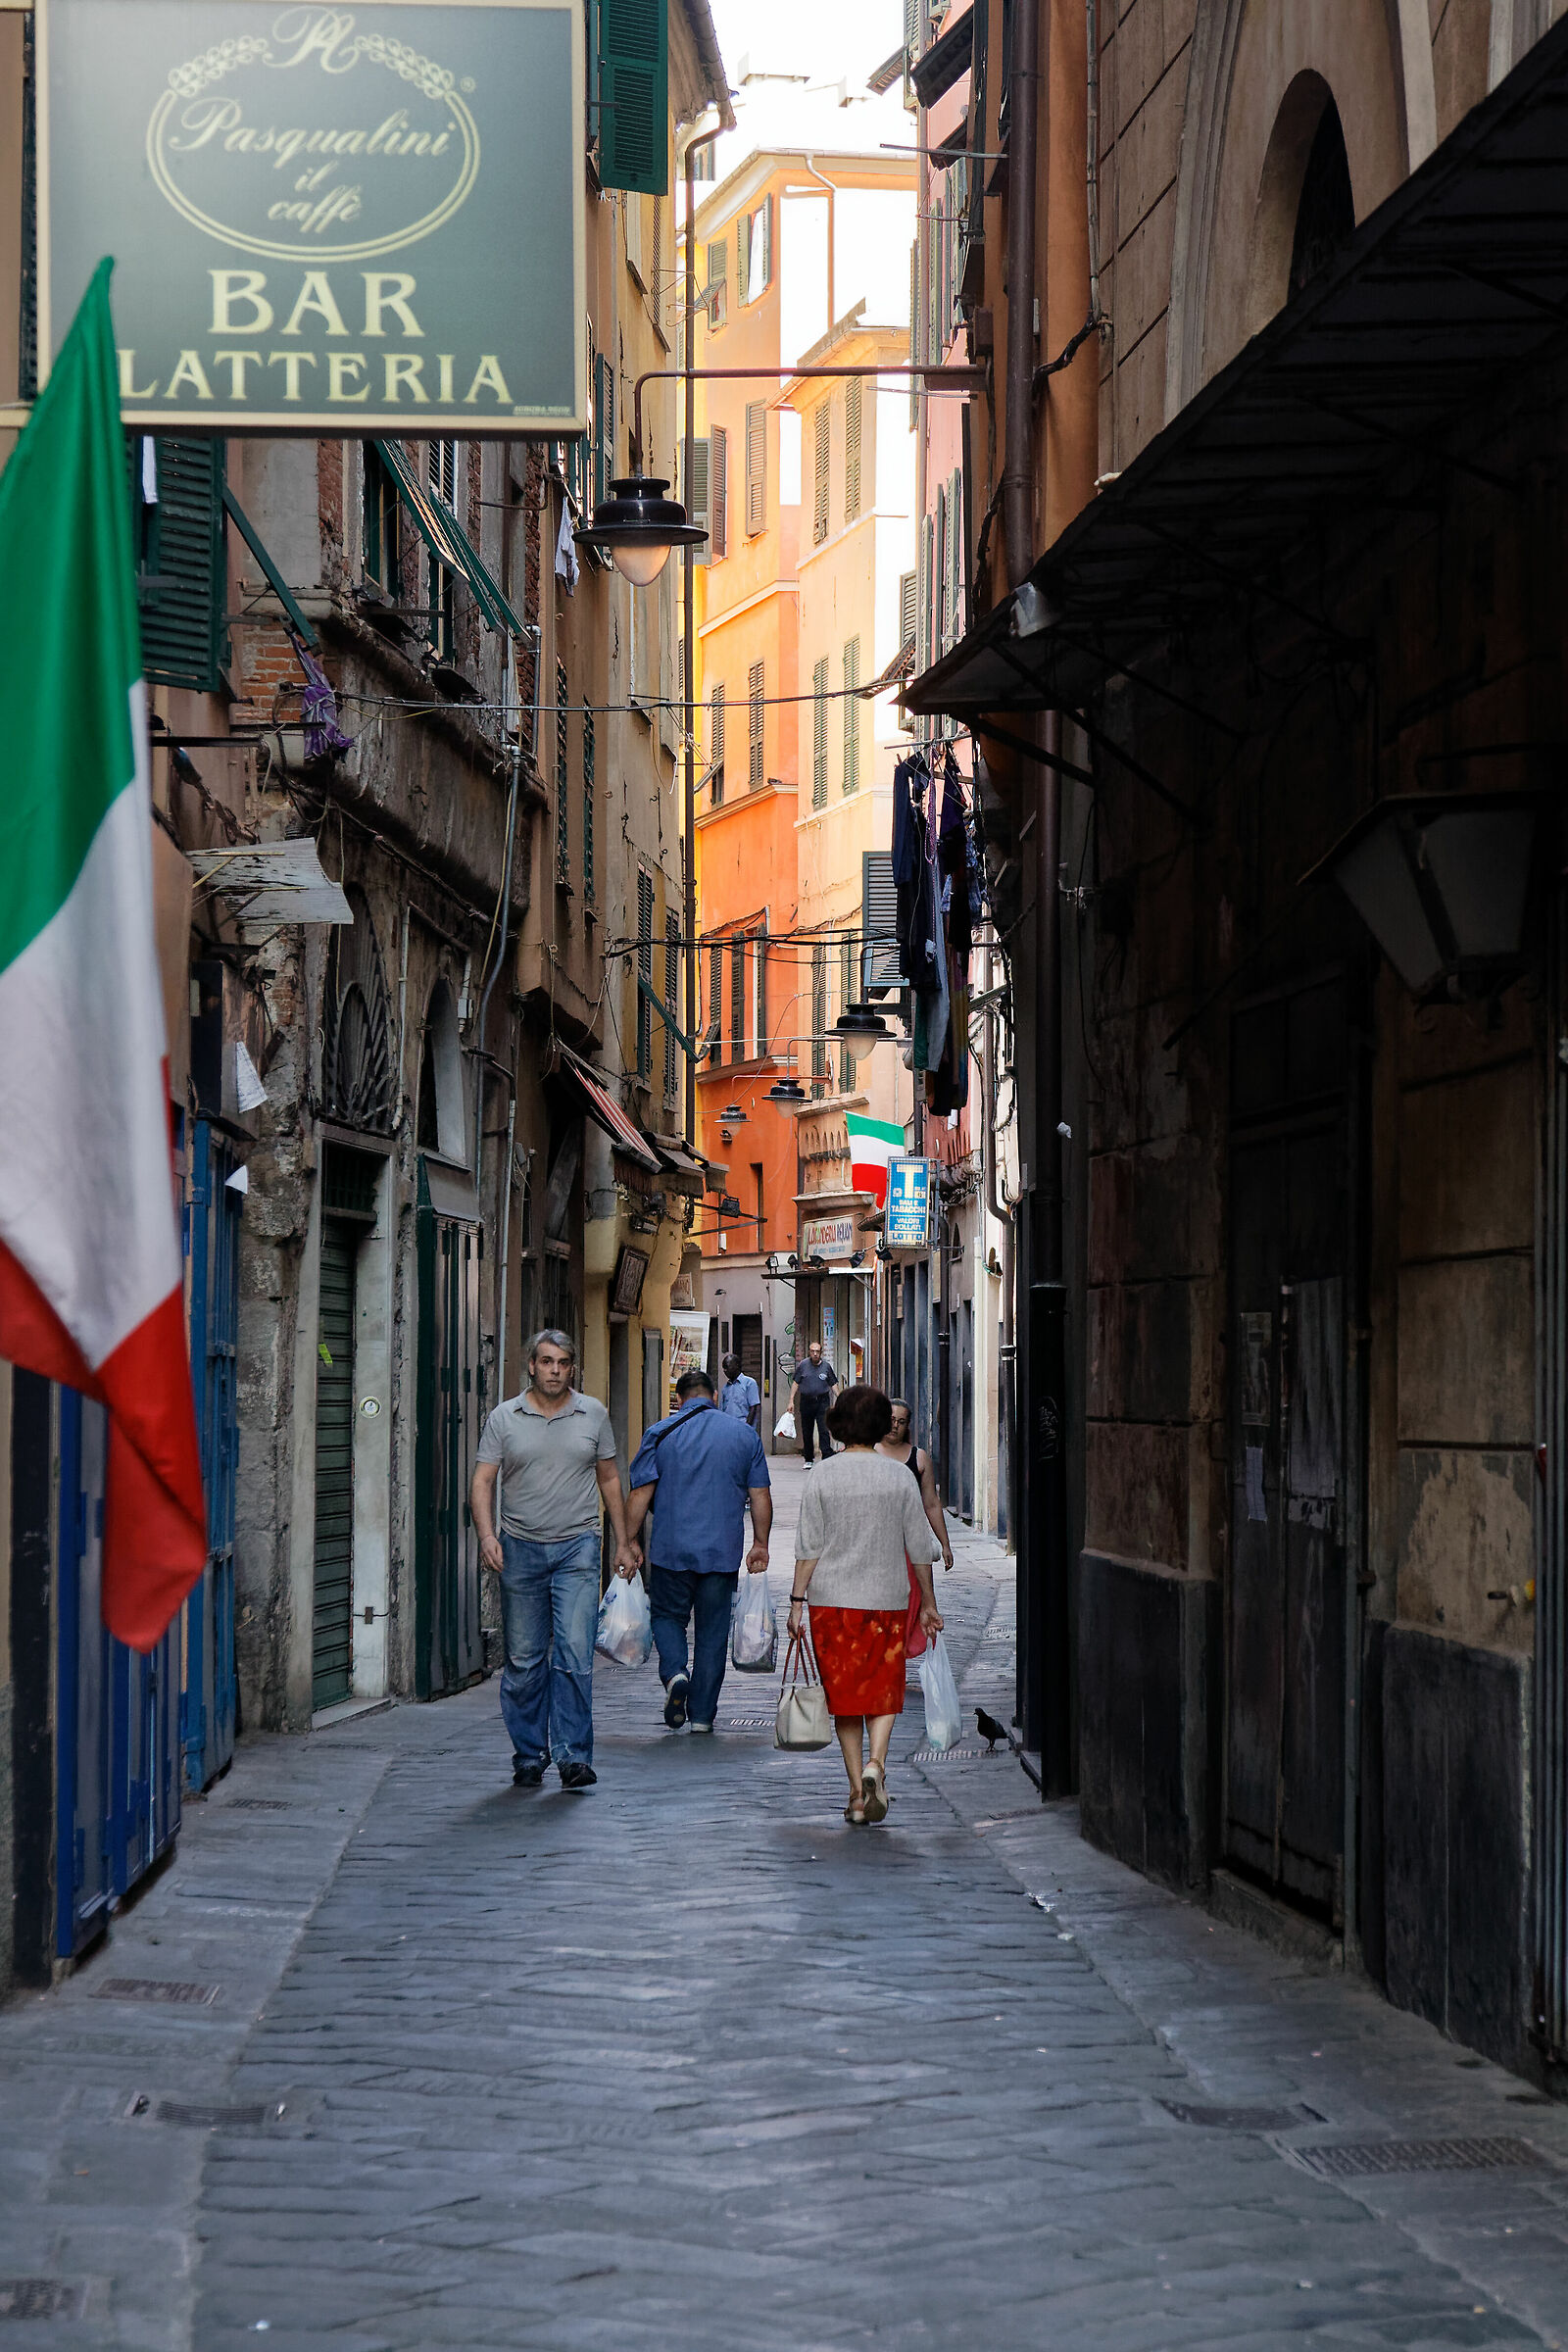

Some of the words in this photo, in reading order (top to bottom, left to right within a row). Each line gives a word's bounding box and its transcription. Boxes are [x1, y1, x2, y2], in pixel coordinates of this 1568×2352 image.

[168, 97, 457, 170] Pasqualini
[294, 159, 339, 192] il
[207, 269, 425, 338] BAR
[118, 349, 514, 405] LATTERIA
[896, 1163, 924, 1200] T
[891, 1204, 926, 1214] TABACCHI
[892, 1232, 922, 1241] LOTTO
